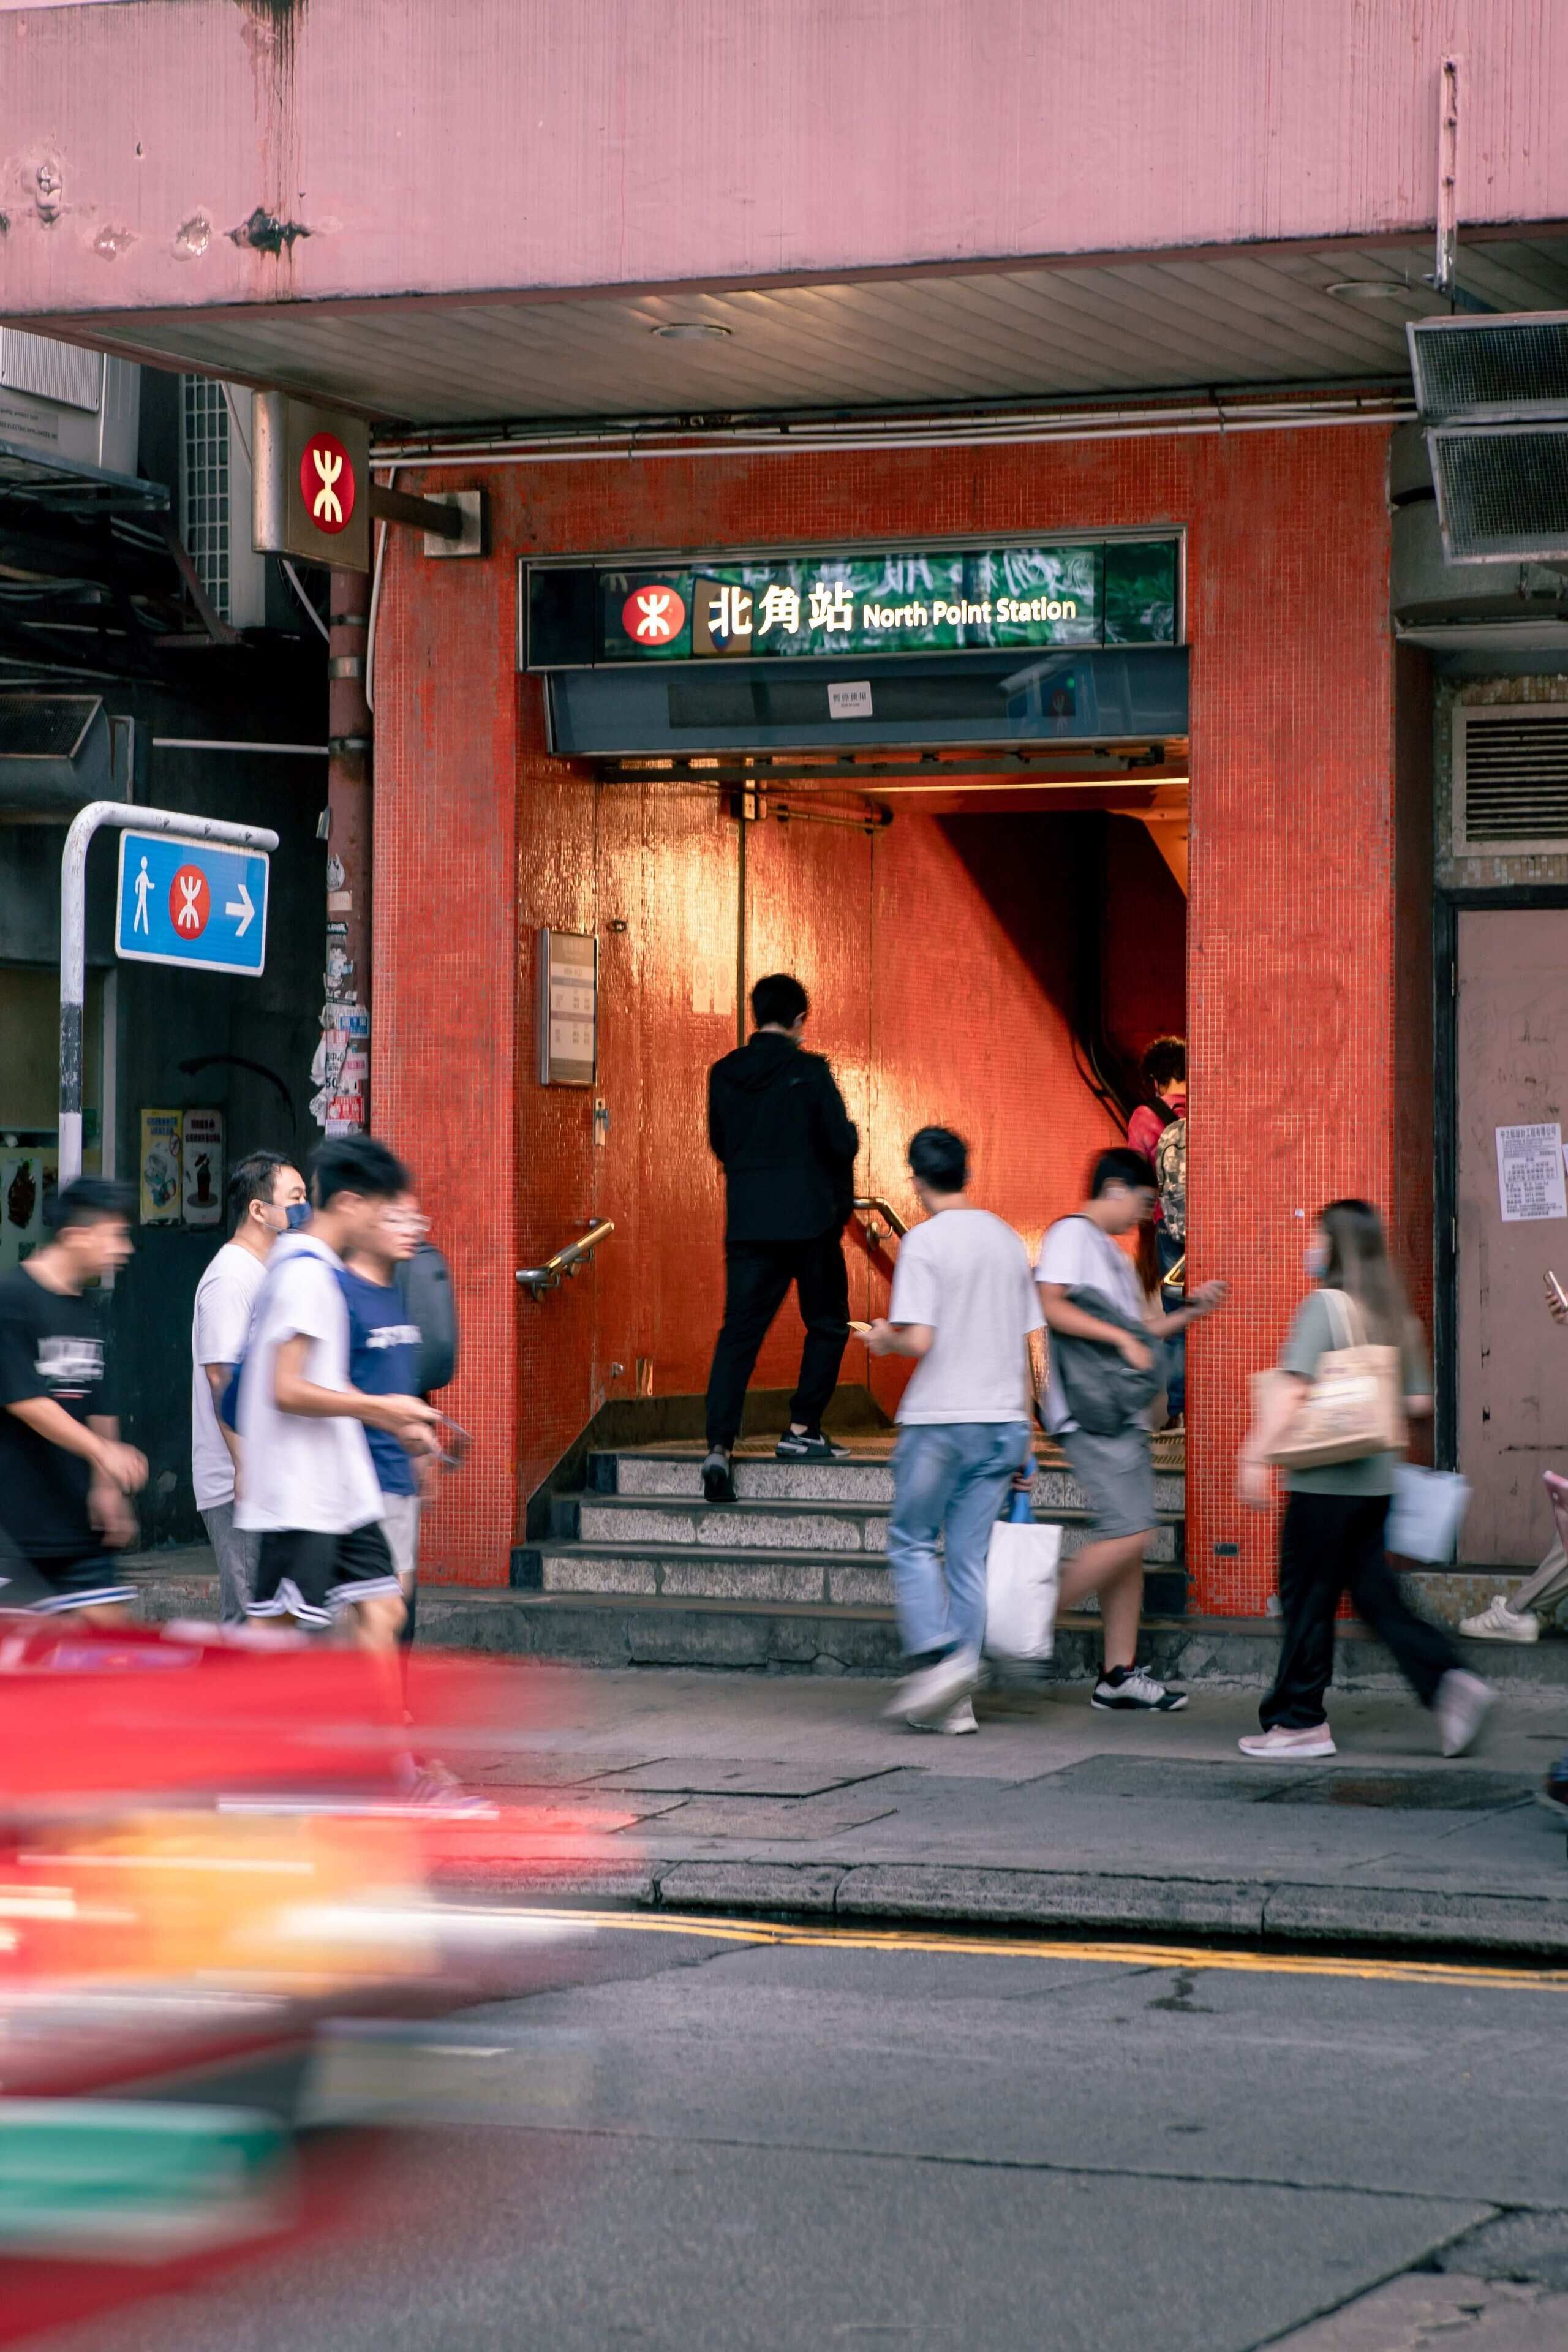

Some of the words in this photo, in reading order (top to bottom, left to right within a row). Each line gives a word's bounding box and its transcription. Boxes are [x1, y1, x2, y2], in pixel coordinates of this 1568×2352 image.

[708, 582, 854, 636] 北角站
[864, 601, 928, 628] North
[933, 600, 992, 626] Point
[996, 597, 1076, 623] Station
